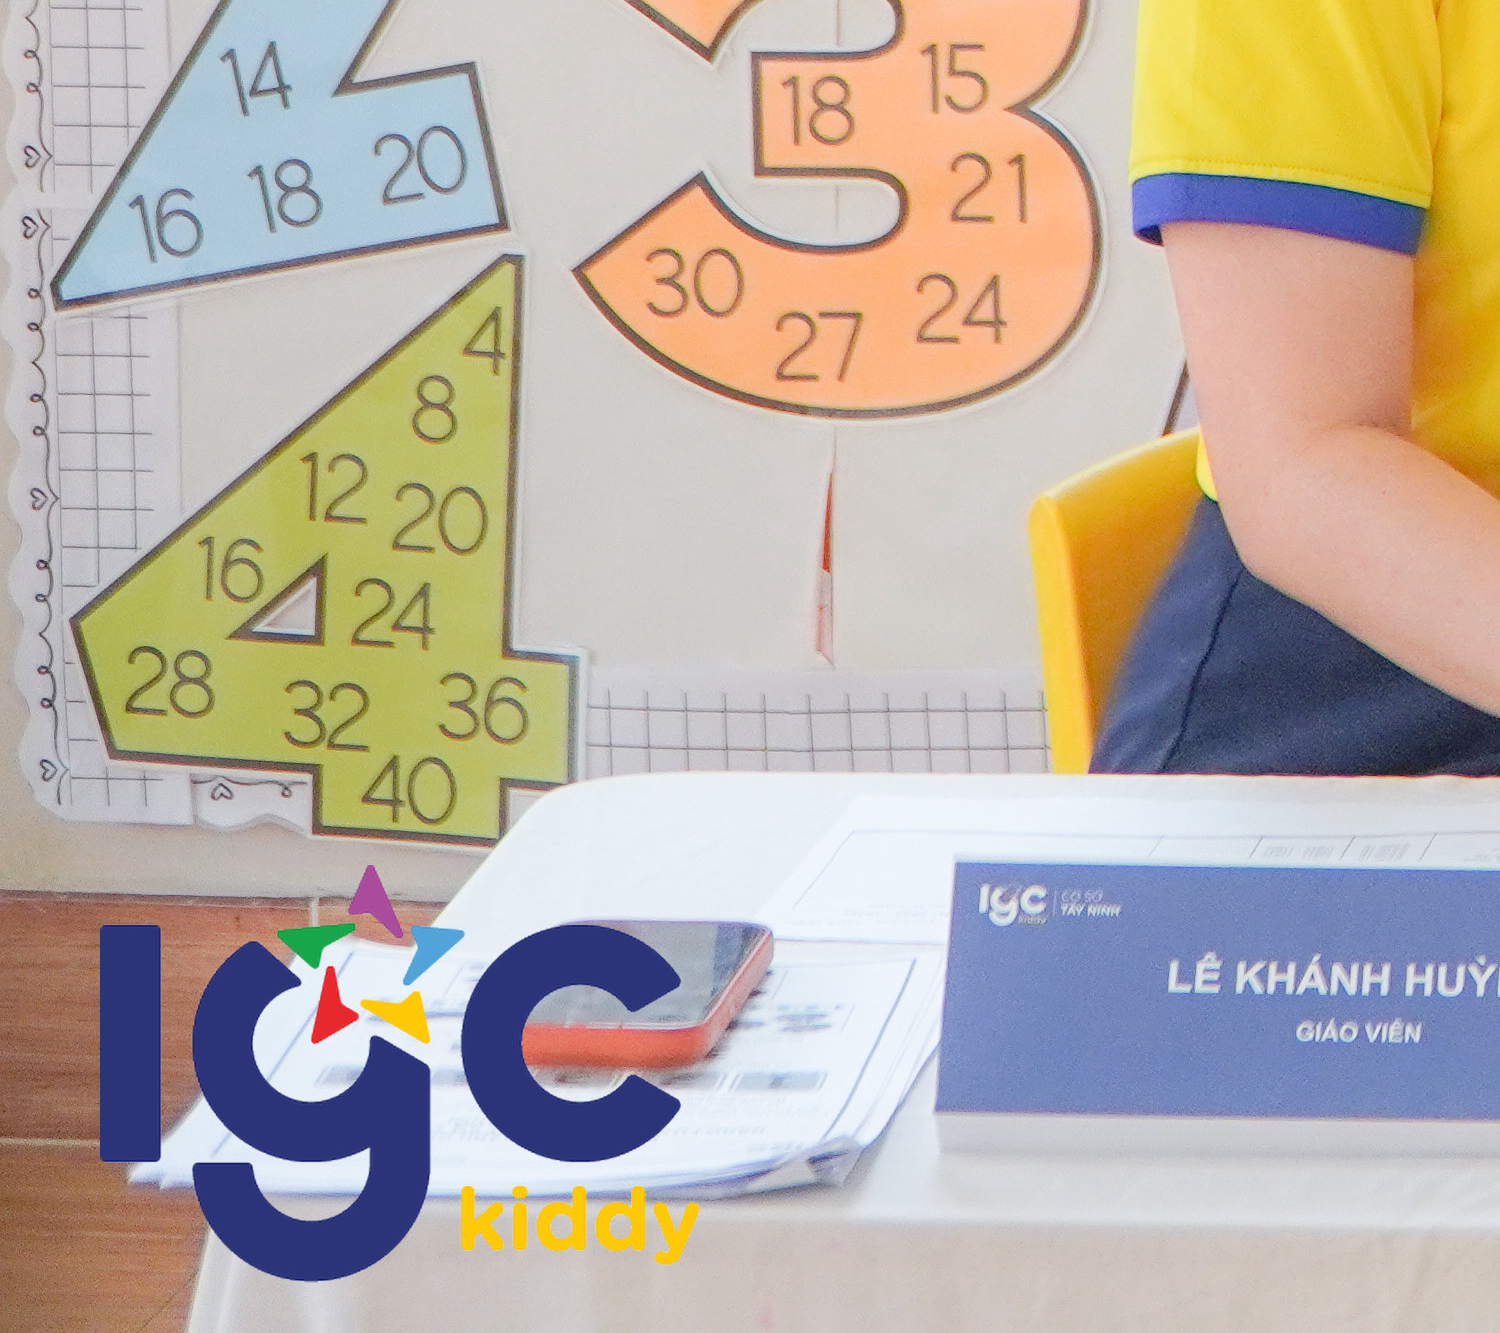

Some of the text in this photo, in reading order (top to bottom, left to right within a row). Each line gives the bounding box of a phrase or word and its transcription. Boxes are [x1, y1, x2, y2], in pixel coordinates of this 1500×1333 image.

[219, 40, 293, 117] 14
[781, 74, 855, 147] 18
[920, 42, 989, 114] 15
[246, 158, 323, 234] 18
[373, 124, 468, 206] 20
[949, 152, 1027, 224] 21
[128, 187, 204, 263] 16
[645, 247, 745, 319] 30
[915, 272, 1008, 345] 24
[462, 305, 507, 376] 4
[774, 310, 864, 382] 27
[411, 374, 458, 444] 8
[299, 451, 369, 525] 12
[391, 481, 489, 556] 20
[197, 535, 264, 604] 16
[350, 577, 435, 651] 24
[124, 645, 215, 719] 28
[283, 679, 370, 753] 32
[437, 671, 529, 745] 36
[360, 754, 457, 825] 40
[1234, 953, 1393, 997] KHÁNH
[1295, 1017, 1423, 1044] GIÁO VIÊN
